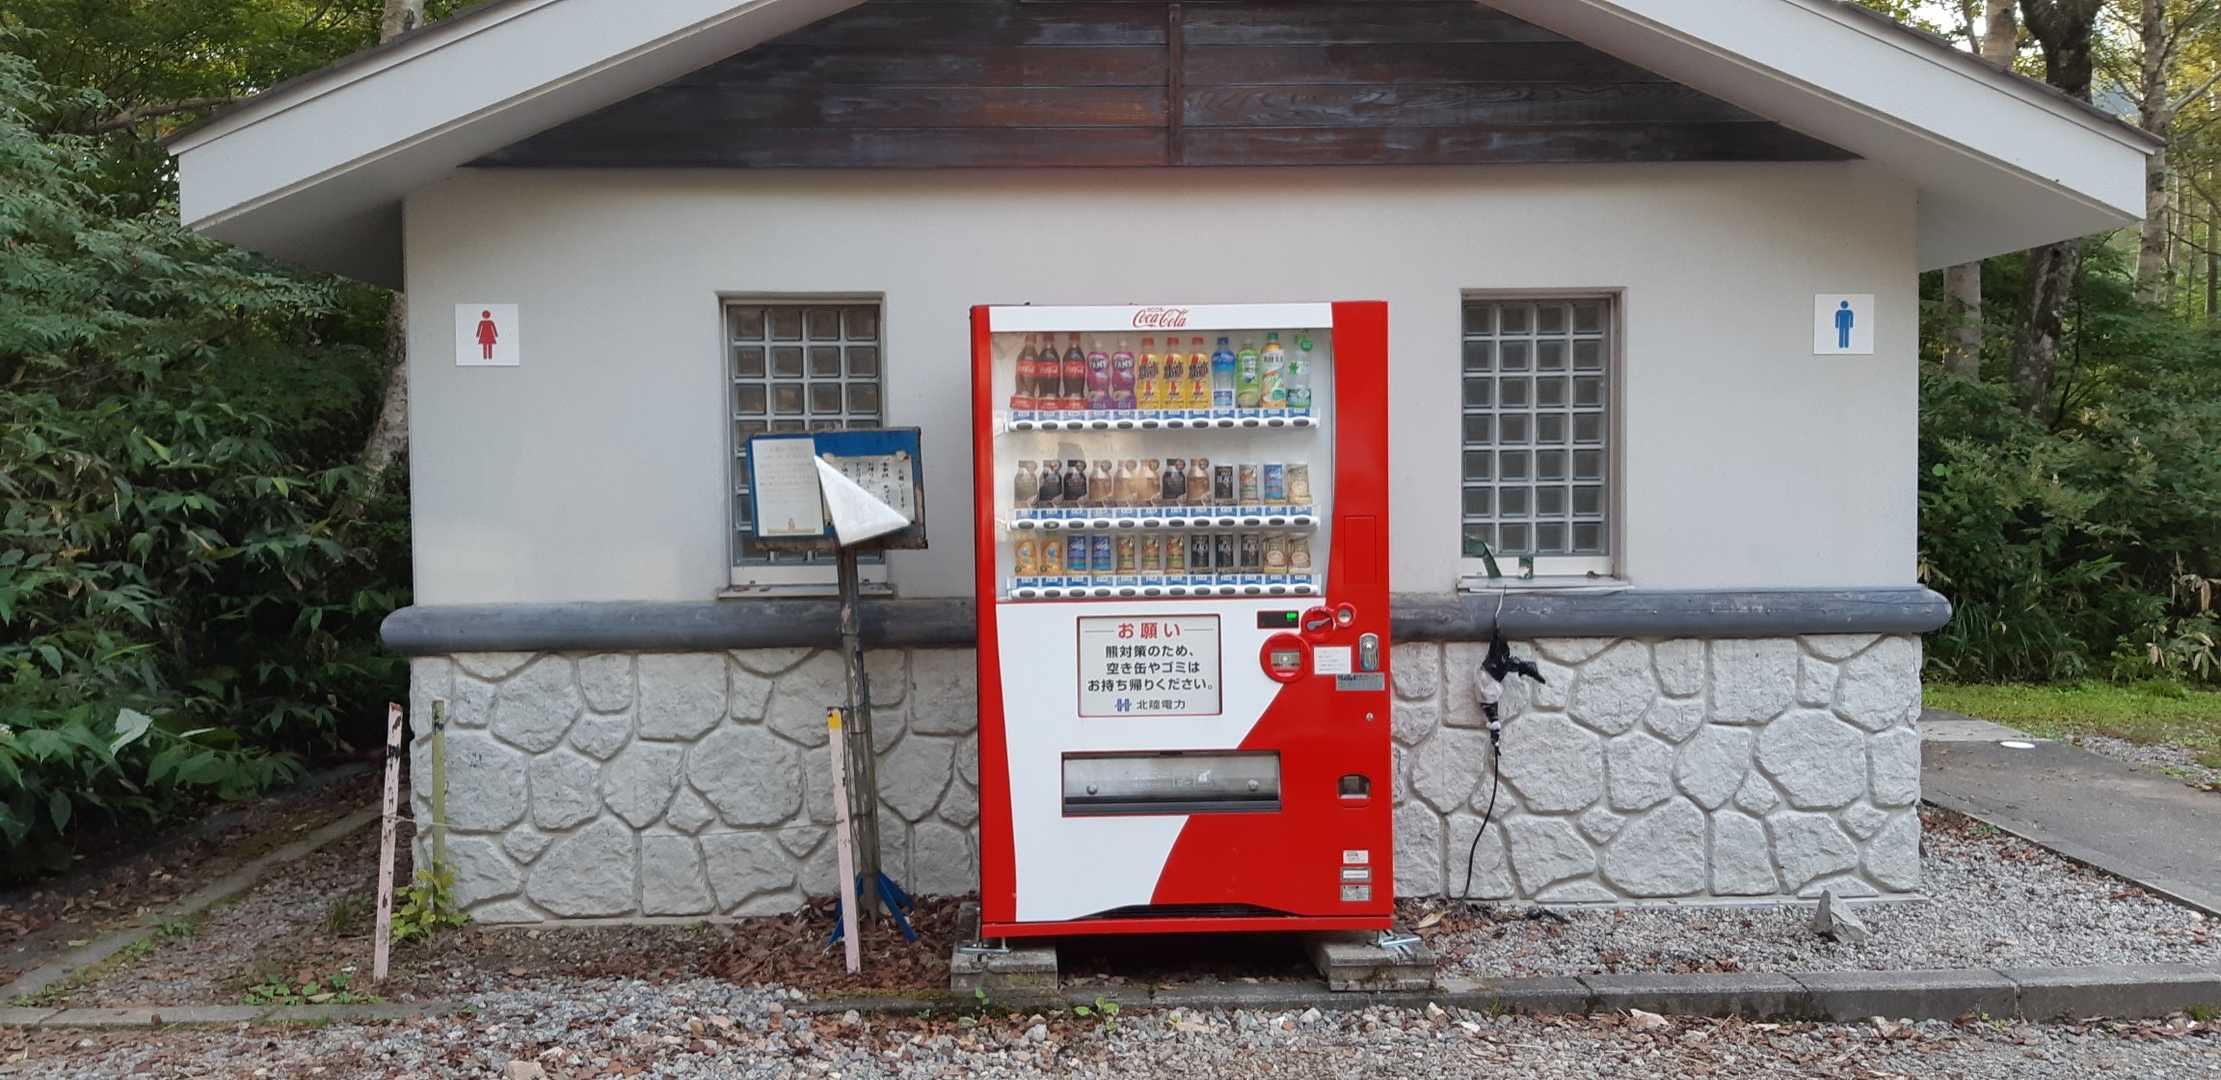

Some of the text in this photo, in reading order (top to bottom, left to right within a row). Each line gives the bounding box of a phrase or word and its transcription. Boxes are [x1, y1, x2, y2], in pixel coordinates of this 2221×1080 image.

[1118, 623, 1181, 639] お願い
[1106, 661, 1200, 675] 空き缶やゴミは
[1088, 678, 1213, 692] お持ち帰りください。
[1136, 699, 1186, 710] 北陸電力
